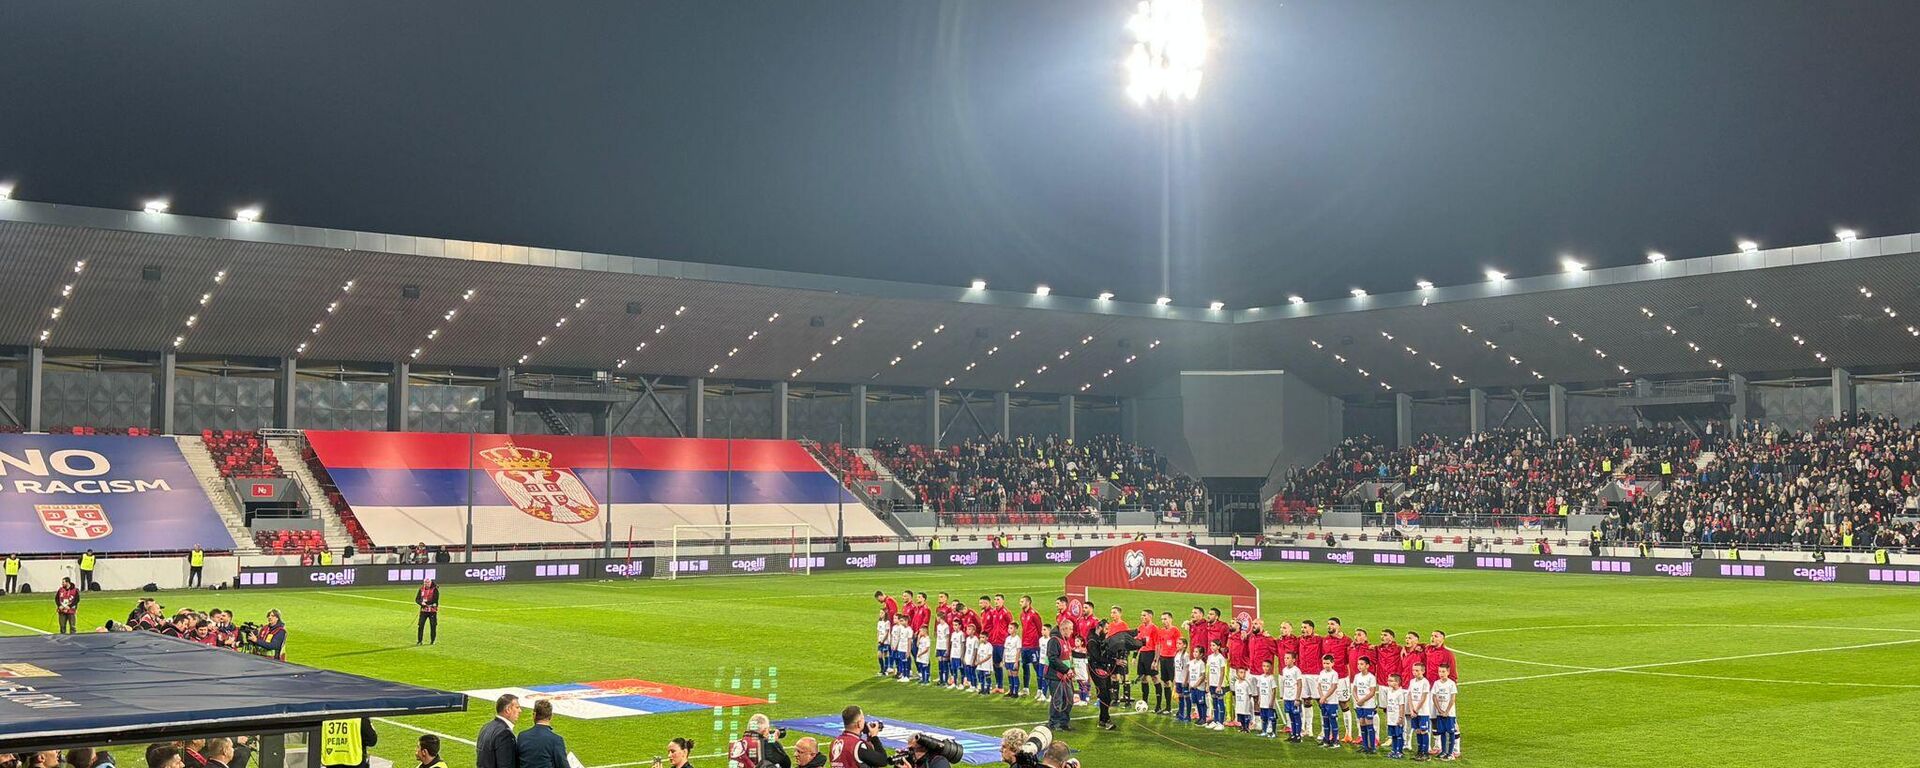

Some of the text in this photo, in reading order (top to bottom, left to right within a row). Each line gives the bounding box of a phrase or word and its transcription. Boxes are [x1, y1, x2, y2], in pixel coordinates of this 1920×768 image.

[0, 449, 111, 476] NO
[14, 479, 172, 494] RACISM
[846, 554, 877, 566] capelli
[950, 551, 978, 564] capelli
[1045, 550, 1071, 561] capelli
[1327, 551, 1354, 563] capelli
[1424, 554, 1454, 567] capelli
[732, 557, 765, 571] capelli
[1149, 557, 1183, 568] EUROPEAN
[1534, 558, 1567, 571] capelli
[1655, 562, 1692, 576] capelli
[310, 568, 355, 585] capelli
[465, 565, 506, 581] capelli
[1145, 567, 1188, 578] QUALIFIERS
[1793, 565, 1836, 581] capelli
[328, 721, 348, 734] 376
